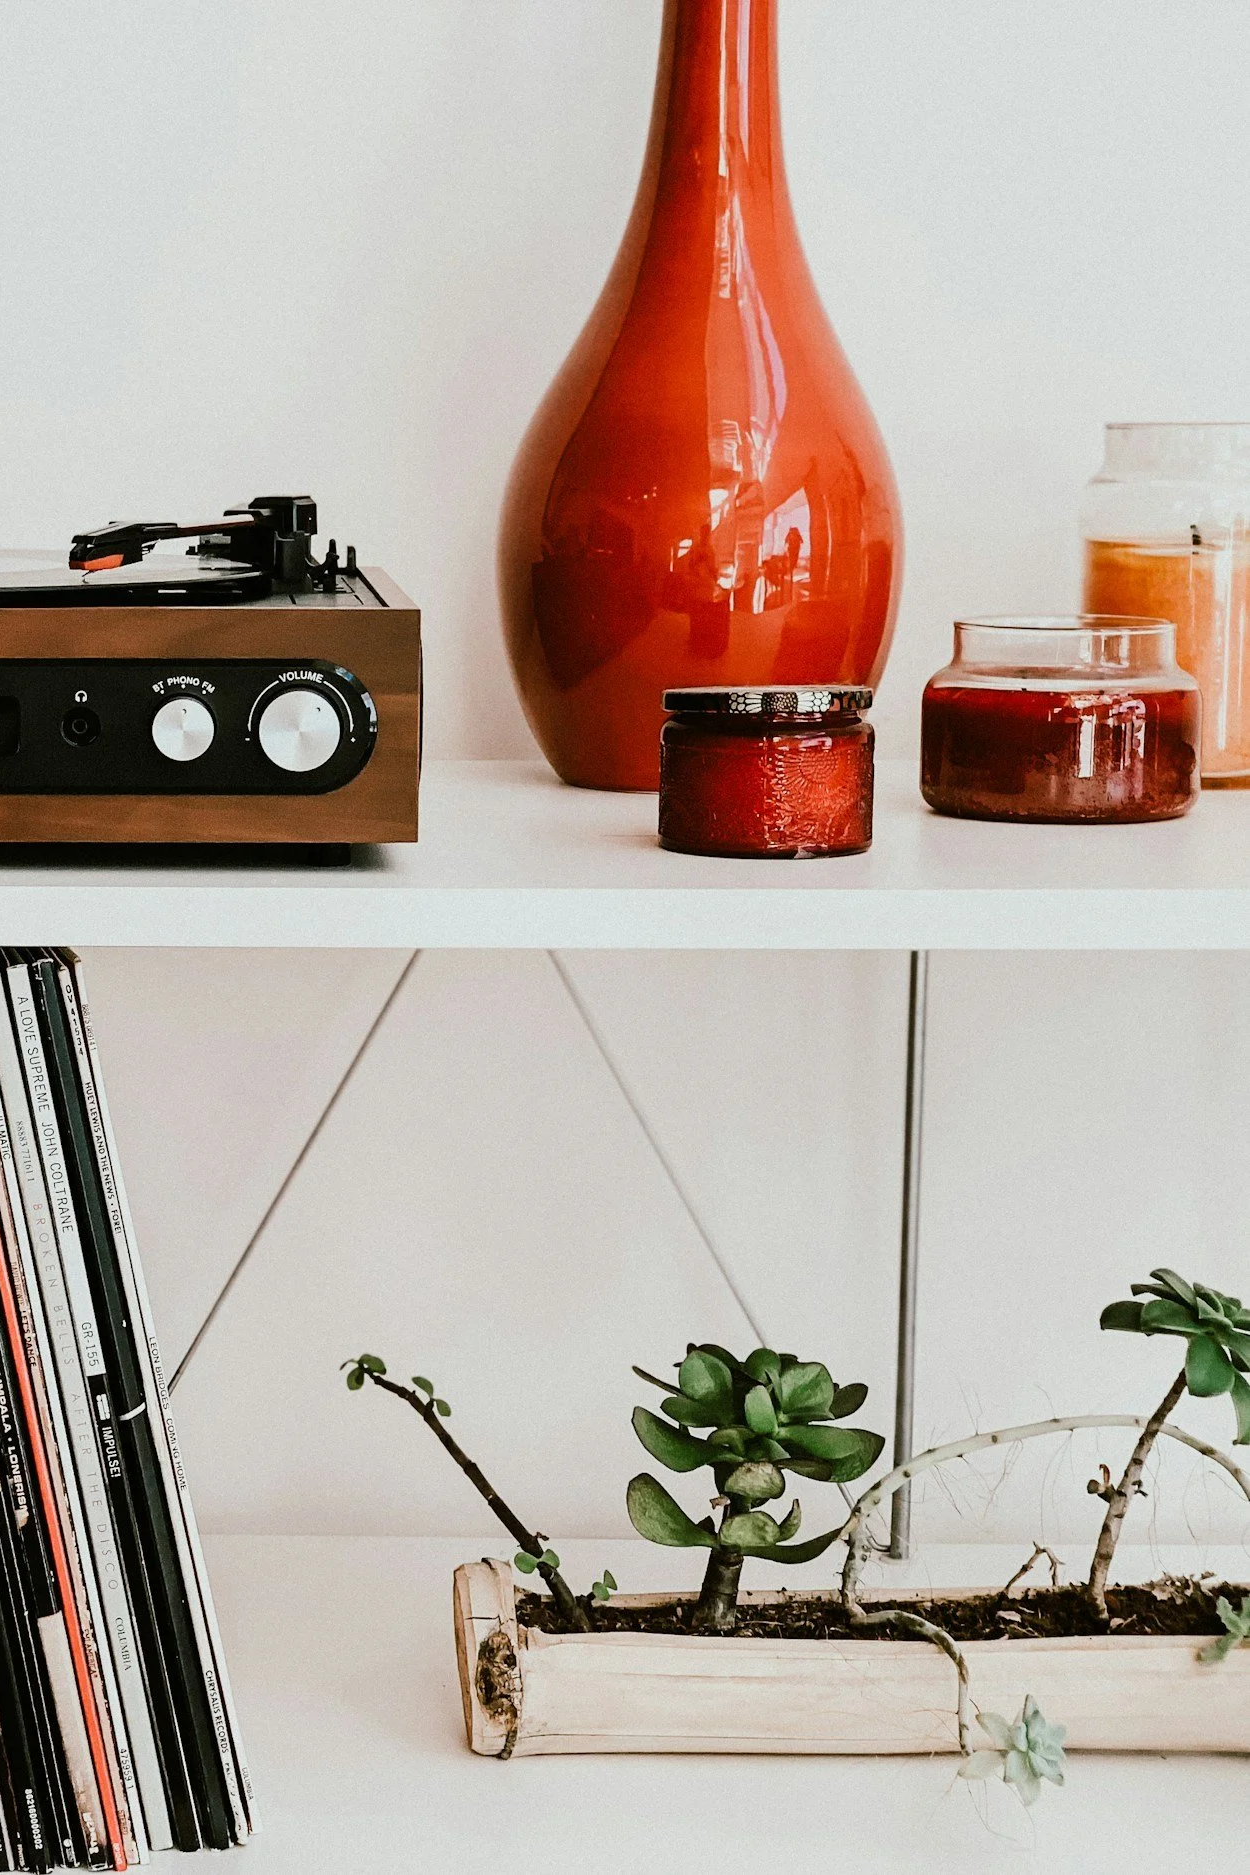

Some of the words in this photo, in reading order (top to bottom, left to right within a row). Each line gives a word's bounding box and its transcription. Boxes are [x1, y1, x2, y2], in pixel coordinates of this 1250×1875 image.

[152, 680, 166, 693] BT
[167, 676, 200, 687] PHONO
[201, 680, 216, 694] FM
[279, 671, 324, 684] VOLUME
[17, 996, 28, 1005] A
[20, 1010, 36, 1042] LOVE
[28, 1048, 50, 1112] SUPREME
[85, 1082, 96, 1104] HUEY
[89, 1106, 102, 1133] LEWIS
[41, 1122, 57, 1157] JOHN
[94, 1135, 106, 1155] AND
[98, 1156, 109, 1173] THE
[50, 1162, 73, 1234] COLTRANE
[103, 1174, 114, 1200] NEWS
[112, 1210, 122, 1234] FORE!
[21, 1310, 32, 1334] LET'S
[24, 1336, 37, 1367] DANCE
[80, 1322, 99, 1367] GR-155
[149, 1337, 161, 1364] LEON
[32, 1203, 58, 1288] BROKEN
[53, 1306, 75, 1366] BELLS
[71, 1394, 92, 1455] AFTER
[87, 1472, 102, 1507] THE
[96, 1524, 118, 1590] DISCO
[154, 1367, 170, 1410] BRIDGES
[101, 1426, 120, 1478] IMPULSE!
[8, 1446, 29, 1518] LONERISM
[176, 1461, 187, 1491] HOME
[114, 1617, 132, 1671] COLUMBIA
[205, 1670, 221, 1714] CHRYSALIS
[215, 1716, 229, 1754] RECORDS
[119, 1749, 132, 1781] 475959
